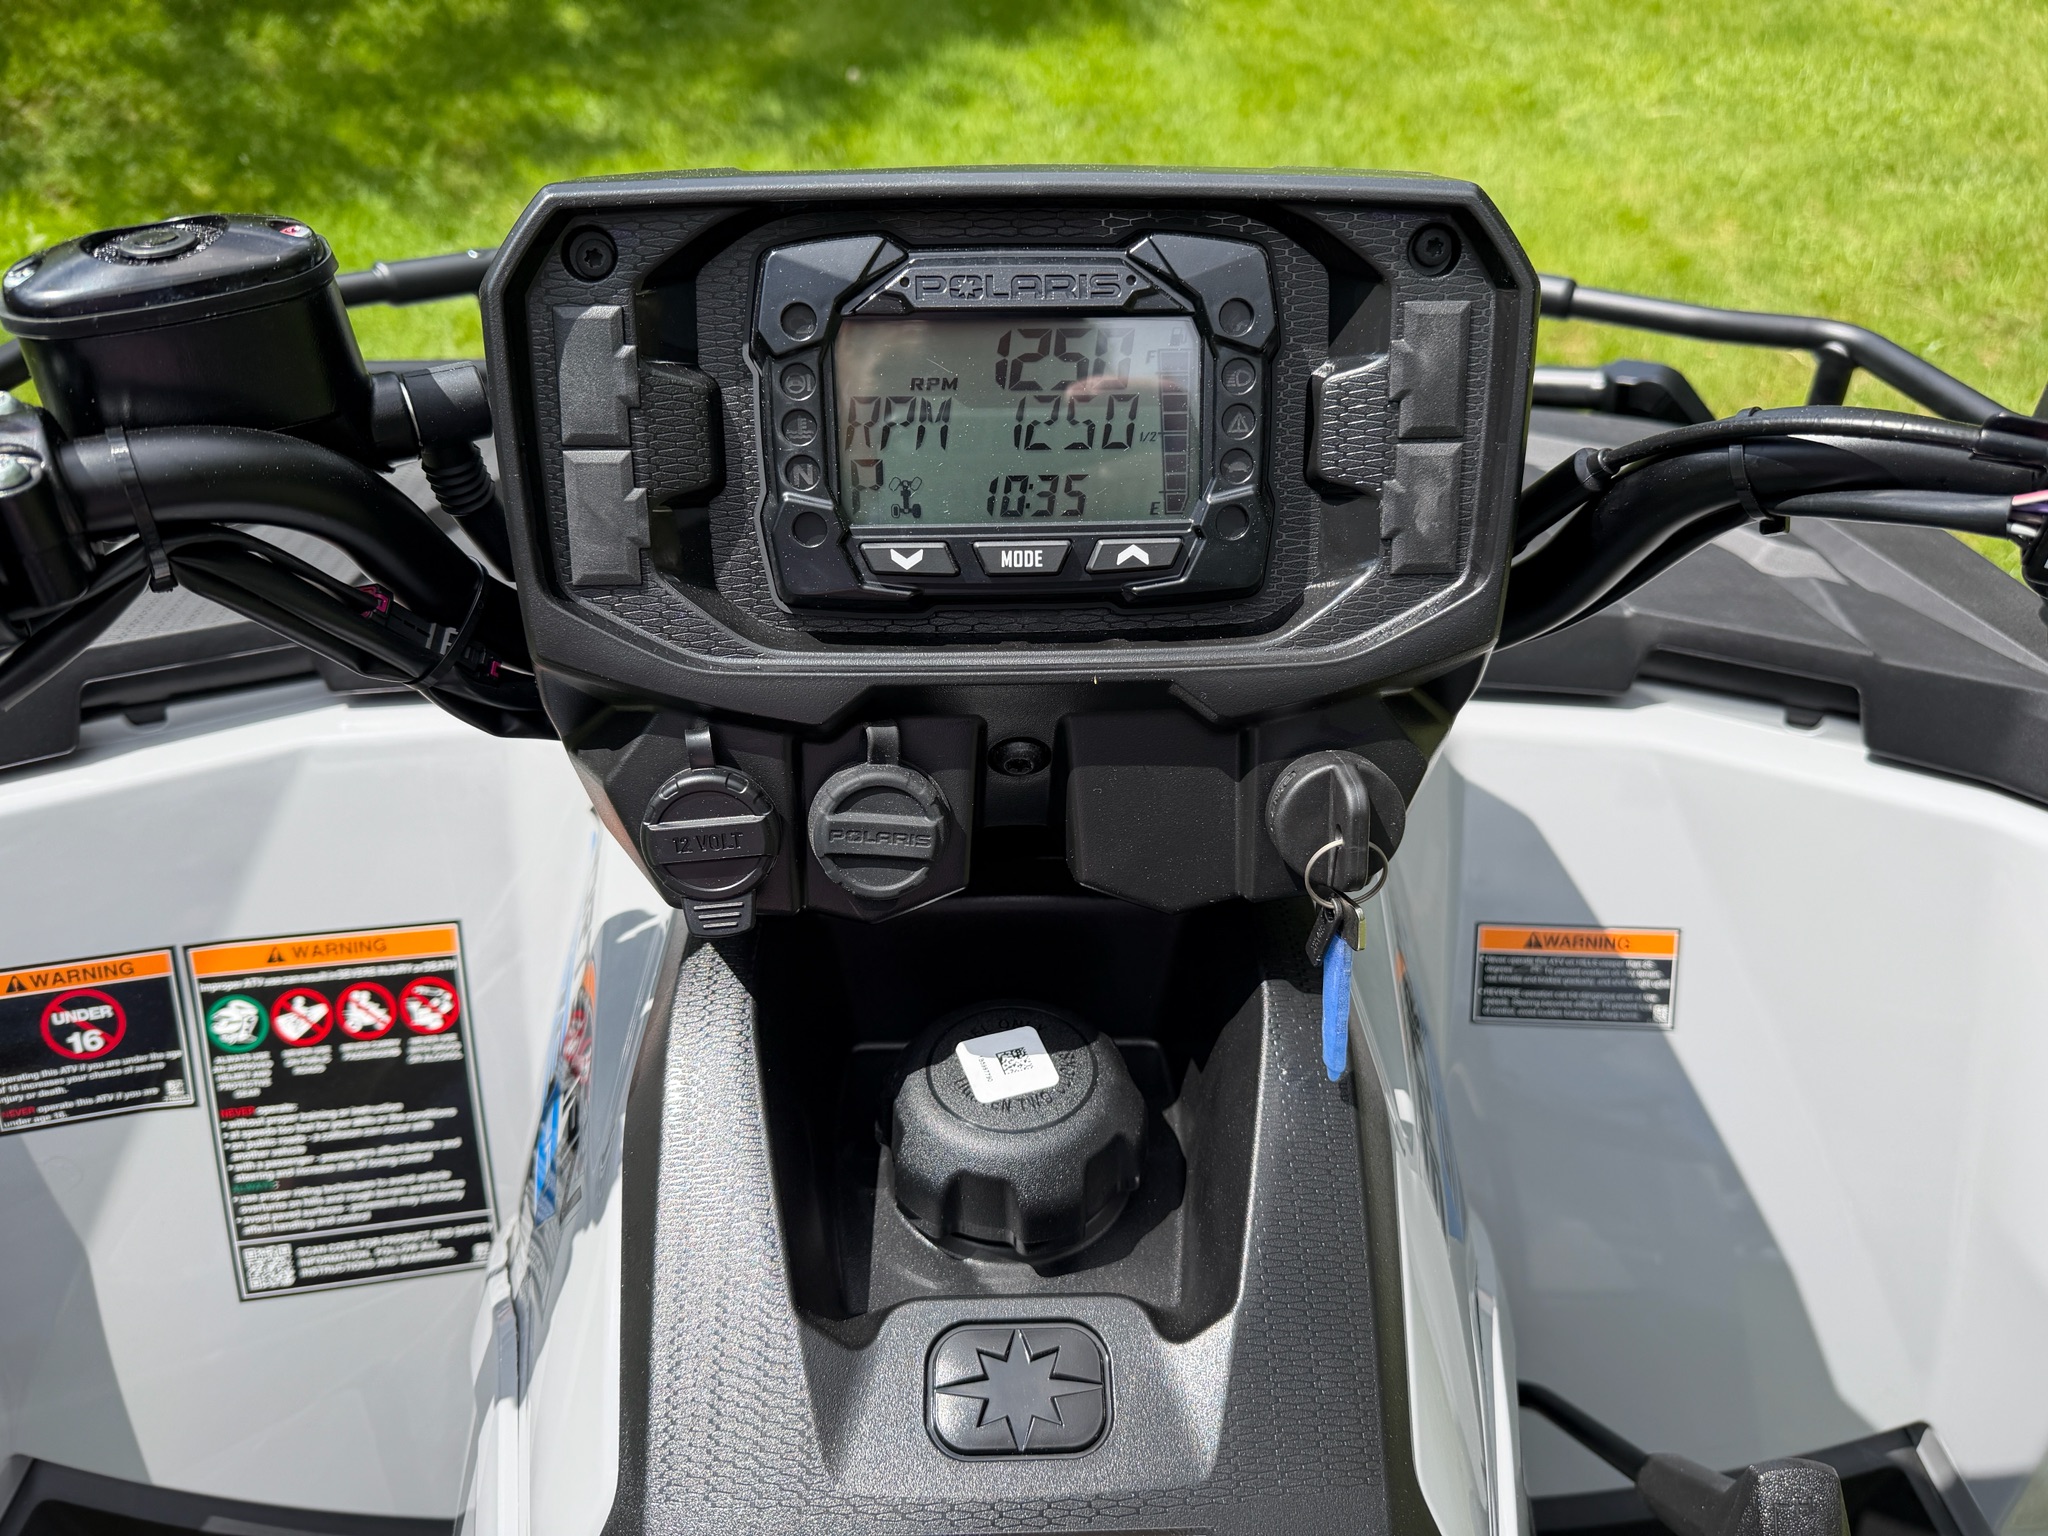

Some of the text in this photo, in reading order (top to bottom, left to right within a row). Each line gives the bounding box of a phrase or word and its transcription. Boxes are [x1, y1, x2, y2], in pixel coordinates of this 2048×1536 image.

[914, 272, 1122, 301] POLARIS
[995, 328, 1135, 391] 1250
[910, 377, 959, 391] RPM
[845, 396, 952, 451] RPM
[1013, 393, 1140, 450] 1250
[851, 459, 1161, 517] P 10:35 E
[1001, 549, 1043, 569] MODE
[672, 831, 744, 855] 12 VOLT
[828, 829, 932, 849] POLARIS
[291, 938, 388, 960] WARNING
[1542, 933, 1631, 951] WARNING
[29, 962, 135, 988] WARNING
[50, 1004, 114, 1026] UNDER
[65, 1029, 105, 1054] 16
[0, 1070, 39, 1085] perating
[41, 1067, 59, 1078] this
[58, 1064, 77, 1075] ATV
[78, 1063, 86, 1072] if
[86, 1061, 104, 1072] you
[121, 1053, 148, 1065] under
[149, 1051, 164, 1061] the
[8, 1084, 19, 1093] 16
[20, 1076, 65, 1091] increases
[66, 1073, 88, 1084] your
[123, 1066, 133, 1074] of
[0, 1093, 25, 1105] njury
[26, 1092, 36, 1100] or
[0, 1105, 36, 1119] NEVER
[36, 1100, 74, 1114] operate
[93, 1093, 114, 1104] ATV
[115, 1091, 123, 1100] if
[124, 1090, 142, 1100] you
[3, 1117, 31, 1127] under
[220, 1105, 256, 1118] NEVER
